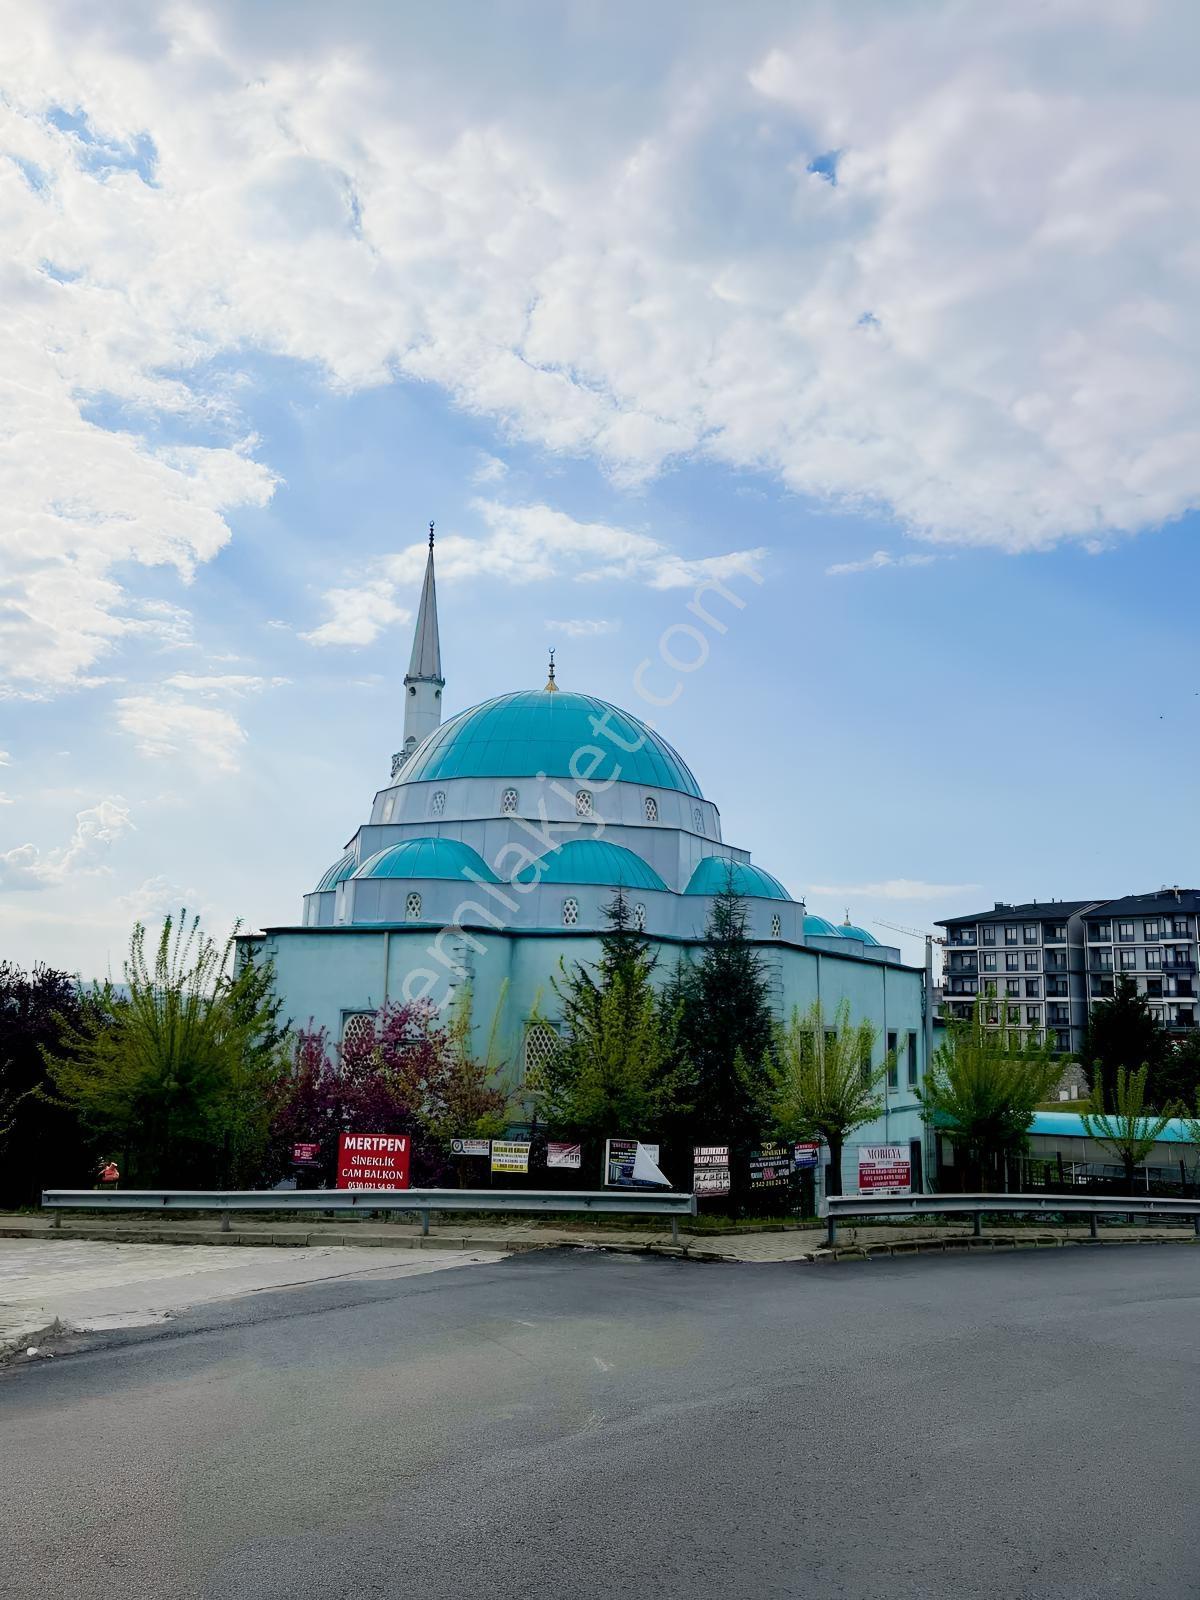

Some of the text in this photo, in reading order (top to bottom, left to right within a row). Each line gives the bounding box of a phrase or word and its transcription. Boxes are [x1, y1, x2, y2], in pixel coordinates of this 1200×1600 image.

[344, 1136, 406, 1152] MERTPEN
[351, 1154, 395, 1167] SİNEKLİK
[342, 1168, 404, 1180] CAM BALKON
